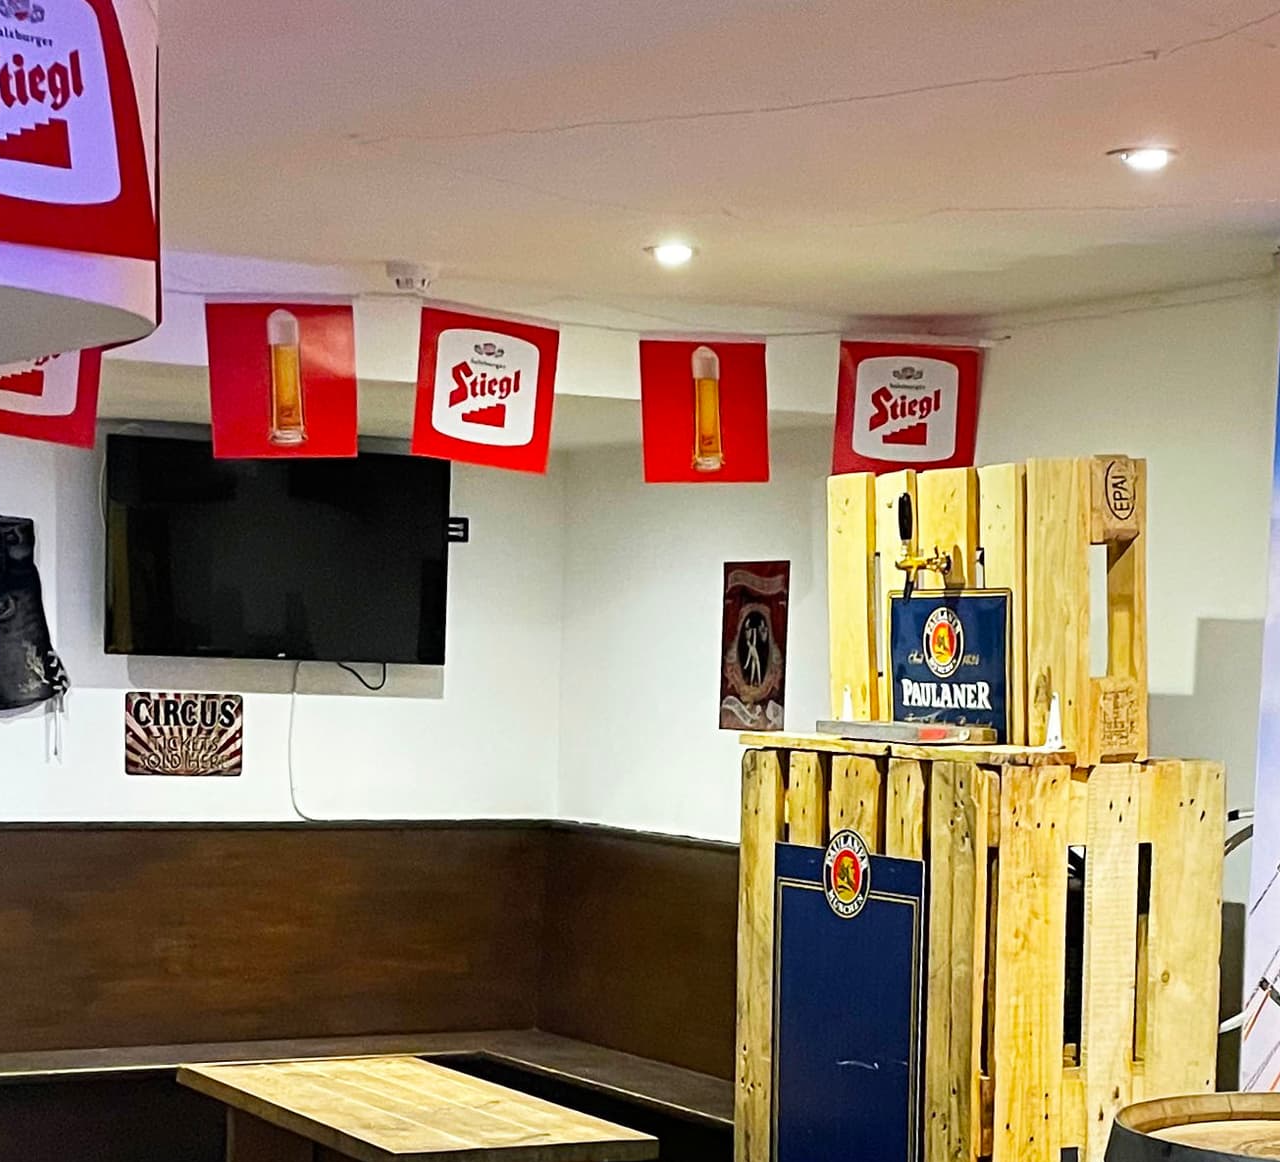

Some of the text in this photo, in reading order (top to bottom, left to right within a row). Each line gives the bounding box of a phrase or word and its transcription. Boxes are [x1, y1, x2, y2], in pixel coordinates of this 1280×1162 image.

[448, 360, 521, 408] Stiegl
[869, 386, 941, 432] Stiegl
[901, 678, 992, 710] PAULANER
[133, 698, 236, 728] CIRCUS
[150, 735, 218, 752] TICKETS
